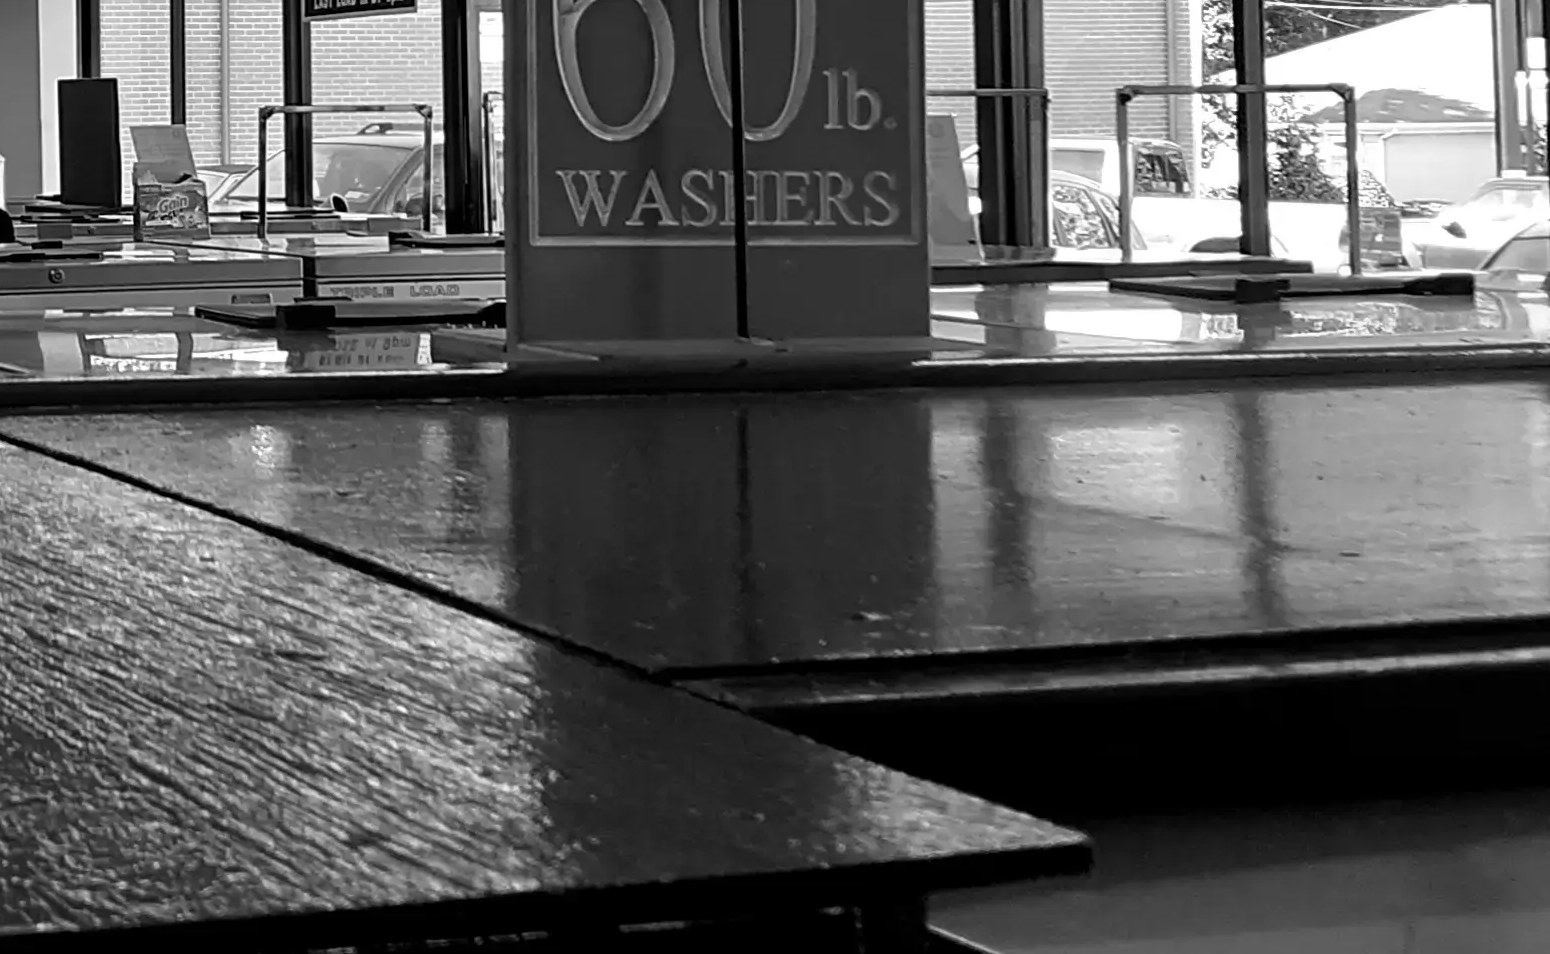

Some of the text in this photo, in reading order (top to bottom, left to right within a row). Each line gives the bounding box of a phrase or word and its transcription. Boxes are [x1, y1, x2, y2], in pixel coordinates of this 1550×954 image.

[822, 67, 897, 131] lb.
[158, 194, 189, 215] Gain
[554, 168, 901, 228] WASHERS
[330, 285, 461, 298] TRIPLE LOAD
